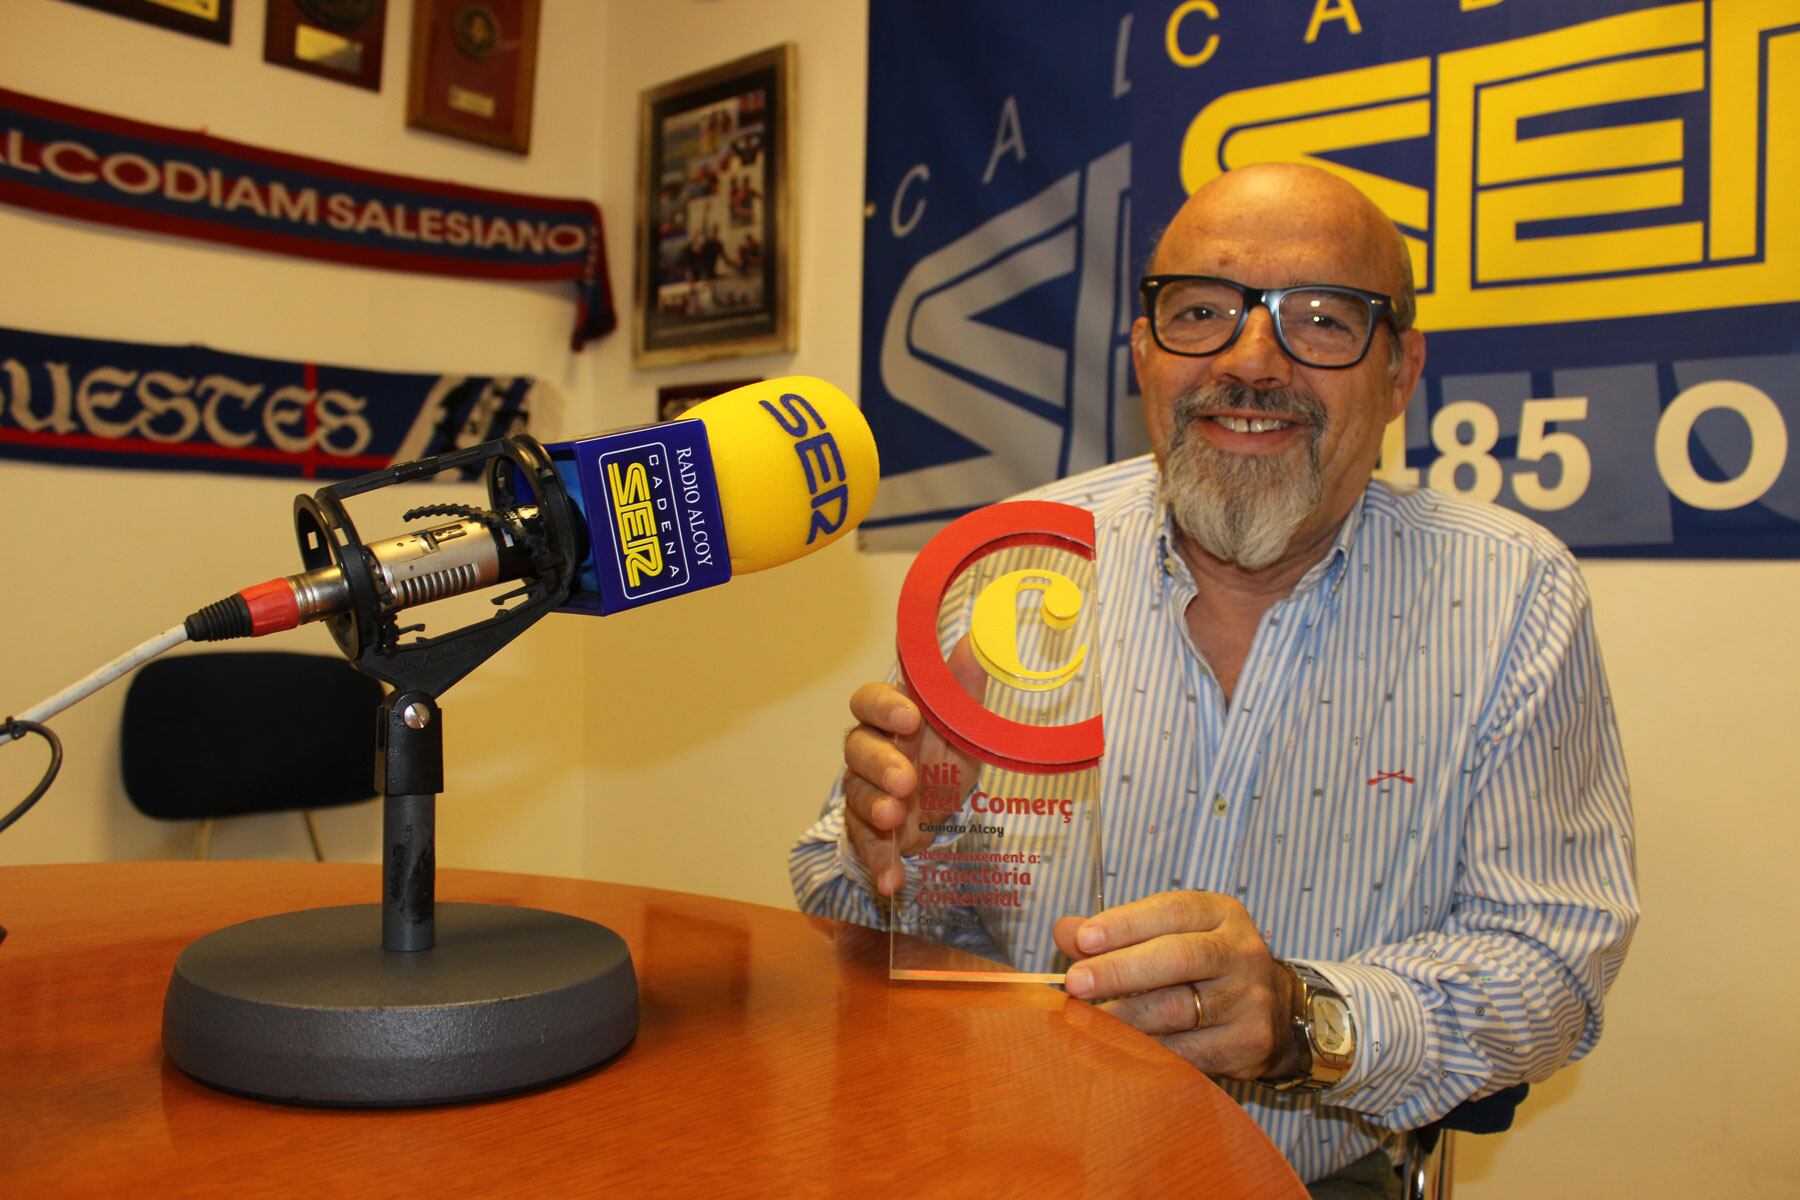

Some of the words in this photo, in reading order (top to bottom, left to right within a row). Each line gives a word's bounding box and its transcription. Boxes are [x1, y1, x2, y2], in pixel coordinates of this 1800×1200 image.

[891, 13, 1133, 238] CA
[0, 129, 318, 225] LCODIAM
[327, 193, 587, 255] SALESIANO
[0, 358, 372, 457] UESTES
[676, 446, 701, 505] RADIO
[758, 393, 849, 545] SER
[607, 462, 664, 588] SER
[648, 454, 680, 578] CADENA
[687, 508, 713, 566] ALCOY
[919, 787, 964, 813] del
[971, 791, 1073, 824] Comerç
[920, 762, 961, 785] Nit
[969, 824, 1005, 838] Alcoy
[1028, 854, 1041, 864] a:
